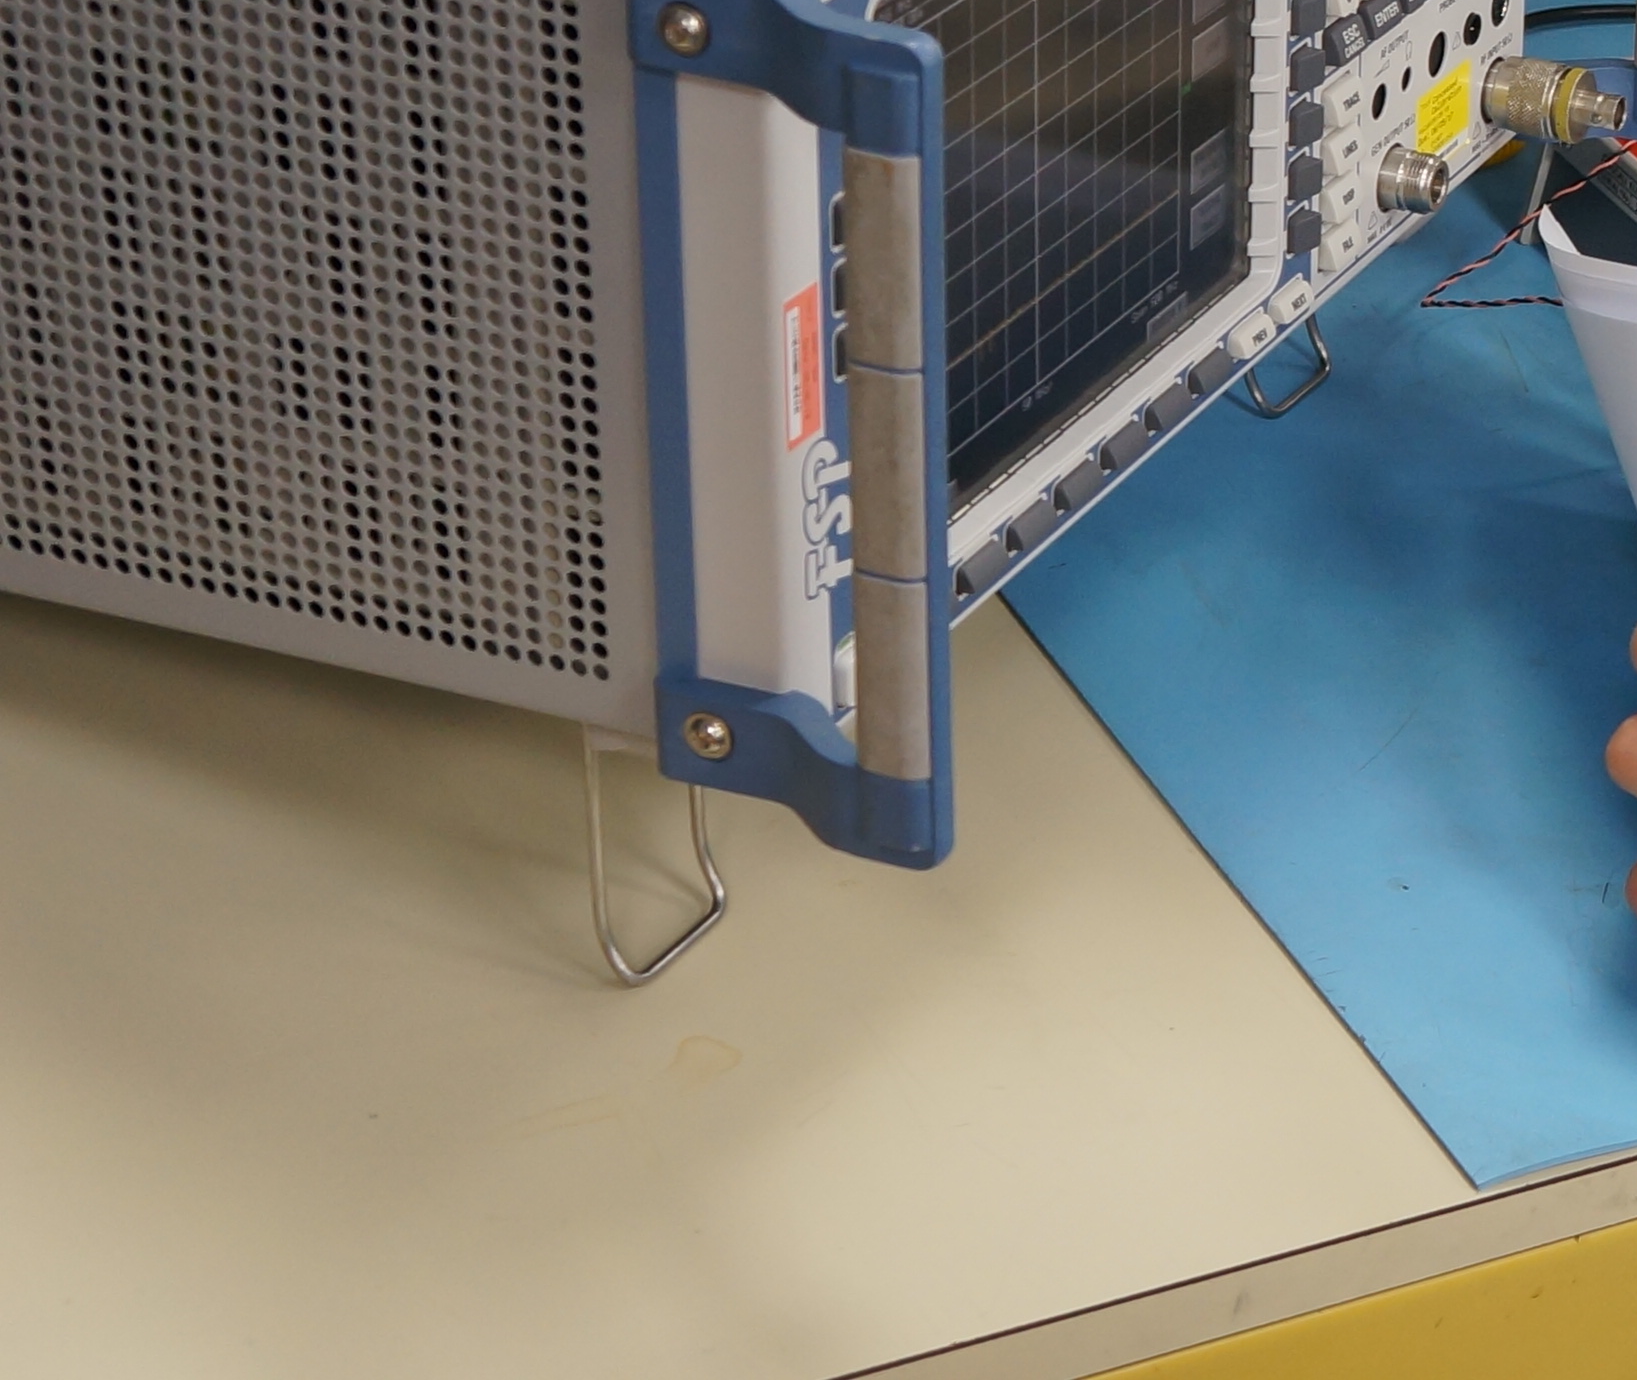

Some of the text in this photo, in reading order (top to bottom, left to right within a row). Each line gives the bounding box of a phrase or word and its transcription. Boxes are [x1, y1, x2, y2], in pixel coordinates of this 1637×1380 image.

[1375, 1, 1399, 28] ENTER
[1342, 24, 1361, 45] ESC
[1291, 292, 1308, 309] NEXT
[1252, 326, 1269, 347] PREV
